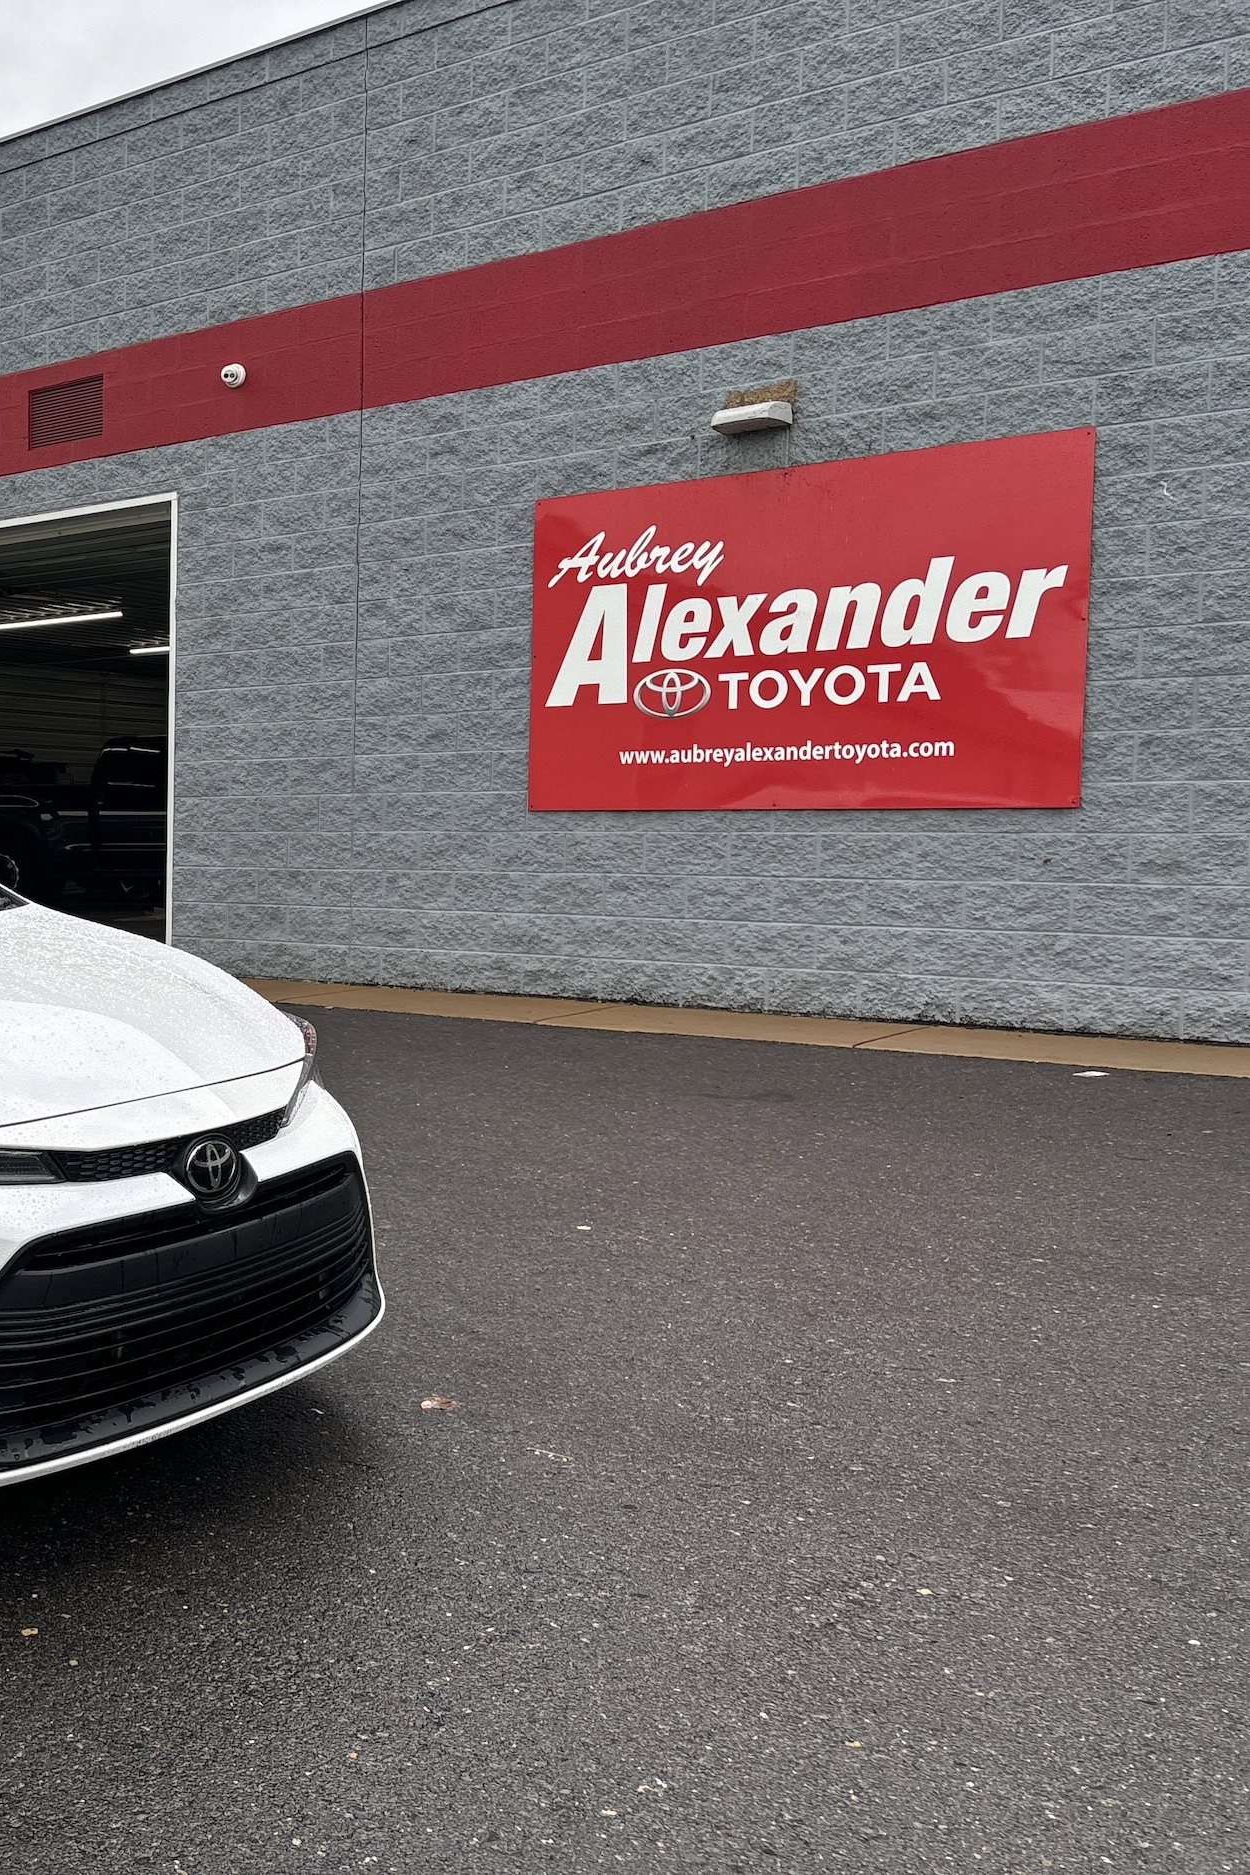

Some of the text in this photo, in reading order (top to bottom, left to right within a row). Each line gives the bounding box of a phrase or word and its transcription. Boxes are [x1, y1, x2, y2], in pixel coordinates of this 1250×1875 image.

[548, 525, 725, 589] Aubrey
[545, 556, 1069, 708] Alexander
[719, 662, 942, 710] TOYOTA
[619, 740, 955, 768] www.aubreyalexandertoyota.com
